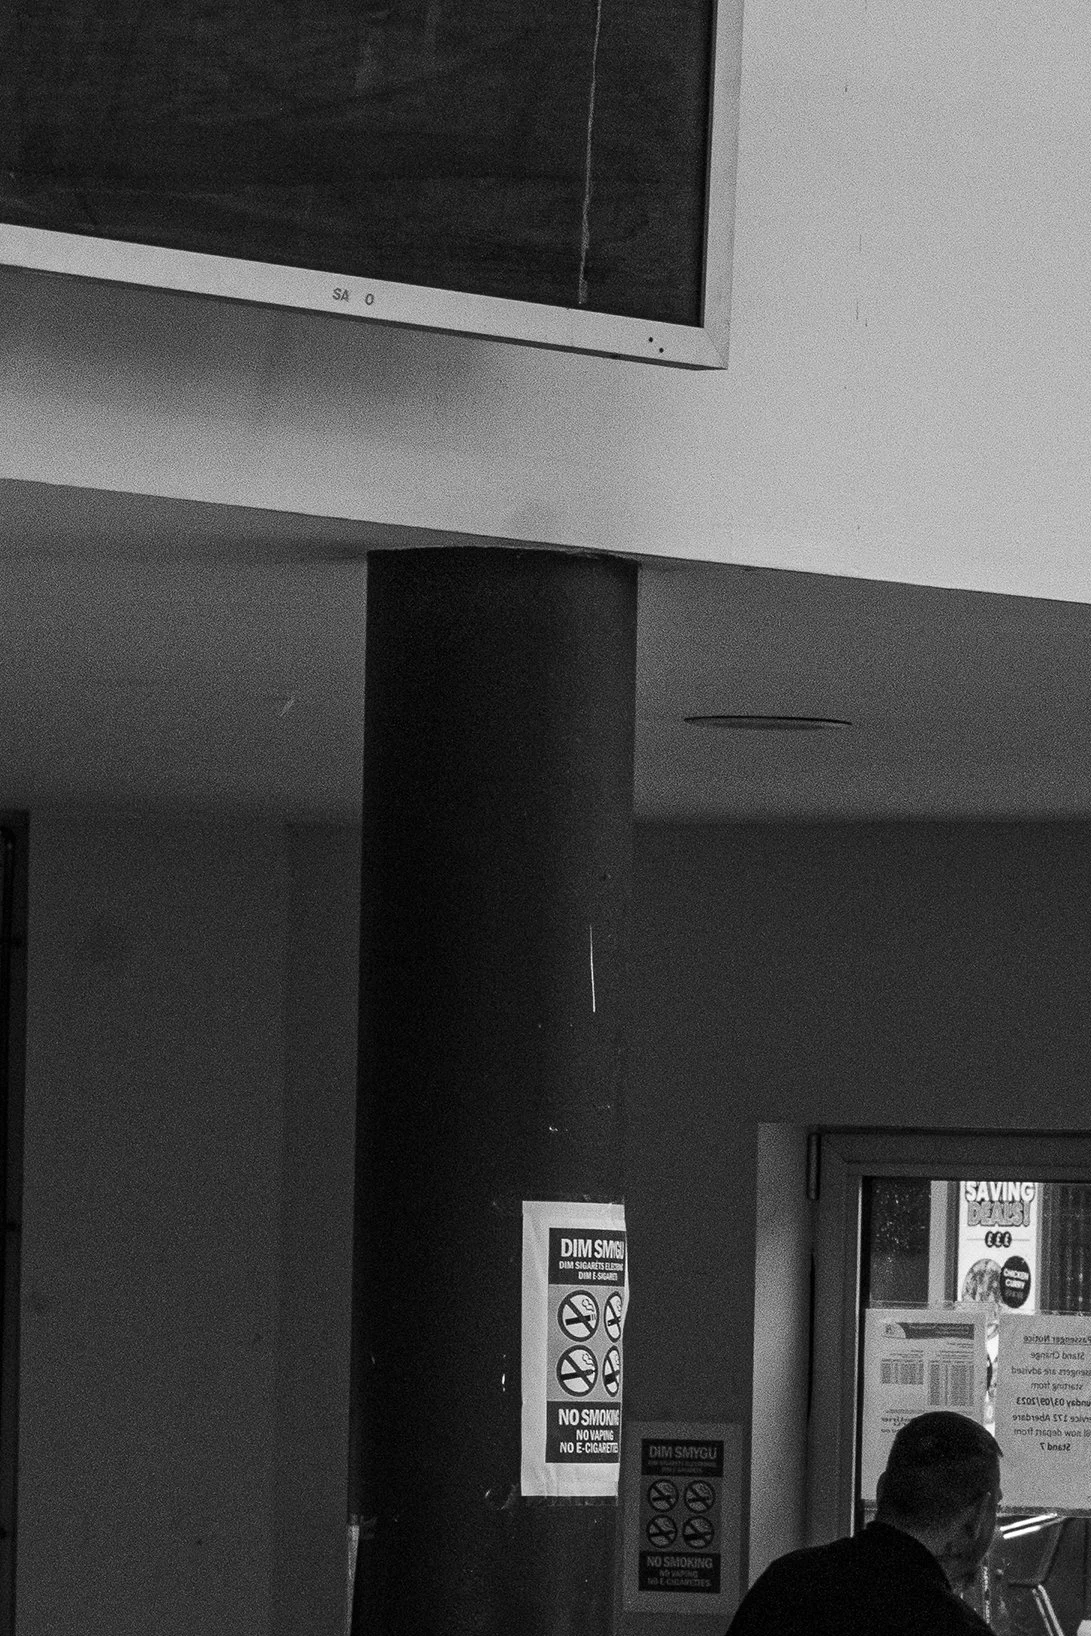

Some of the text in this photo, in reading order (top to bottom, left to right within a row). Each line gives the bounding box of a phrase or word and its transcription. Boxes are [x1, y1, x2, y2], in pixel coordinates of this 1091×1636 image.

[964, 1181, 1035, 1203] SAVING
[967, 1201, 1031, 1227] DEALS!
[560, 1238, 593, 1259] DIM
[559, 1260, 575, 1270] DIM
[578, 1271, 592, 1281] DIM
[558, 1408, 580, 1426] NO
[576, 1429, 615, 1442] NO VAPING
[560, 1442, 575, 1453] NO
[649, 1446, 717, 1460] DIM SMYGU
[647, 1556, 713, 1569] NO SMOKING
